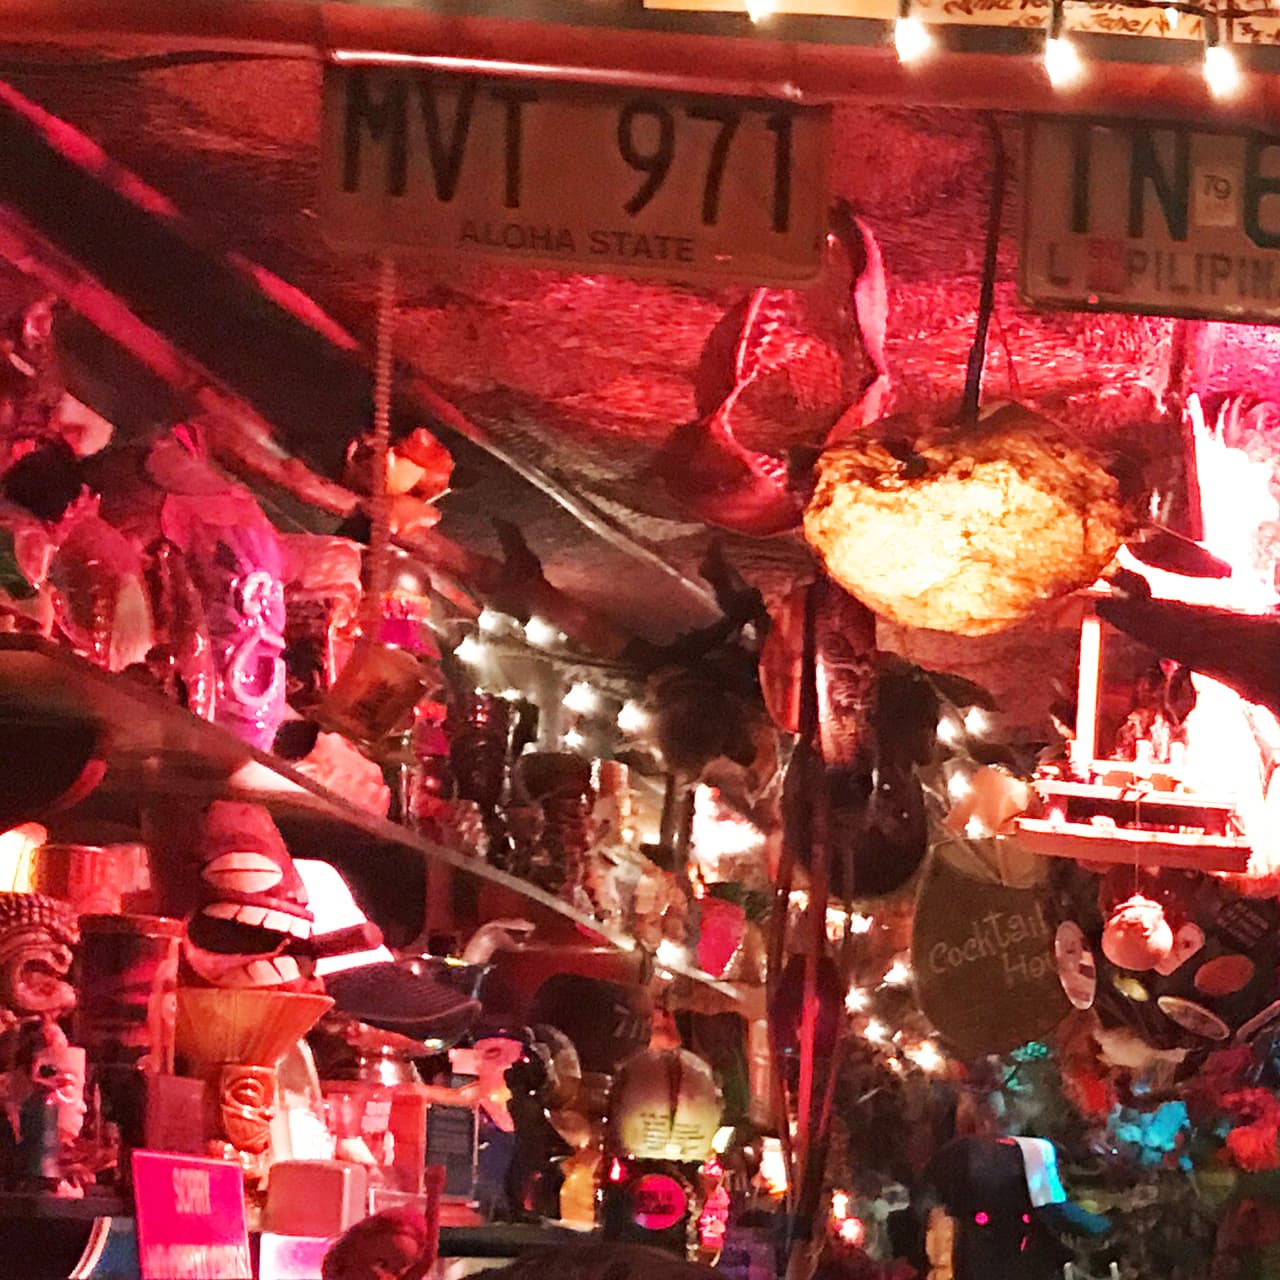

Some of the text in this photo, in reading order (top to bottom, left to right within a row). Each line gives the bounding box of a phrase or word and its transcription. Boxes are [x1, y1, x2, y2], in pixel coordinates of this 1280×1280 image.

[341, 74, 795, 235] MVT 971
[458, 217, 697, 264] ALOHA STATE
